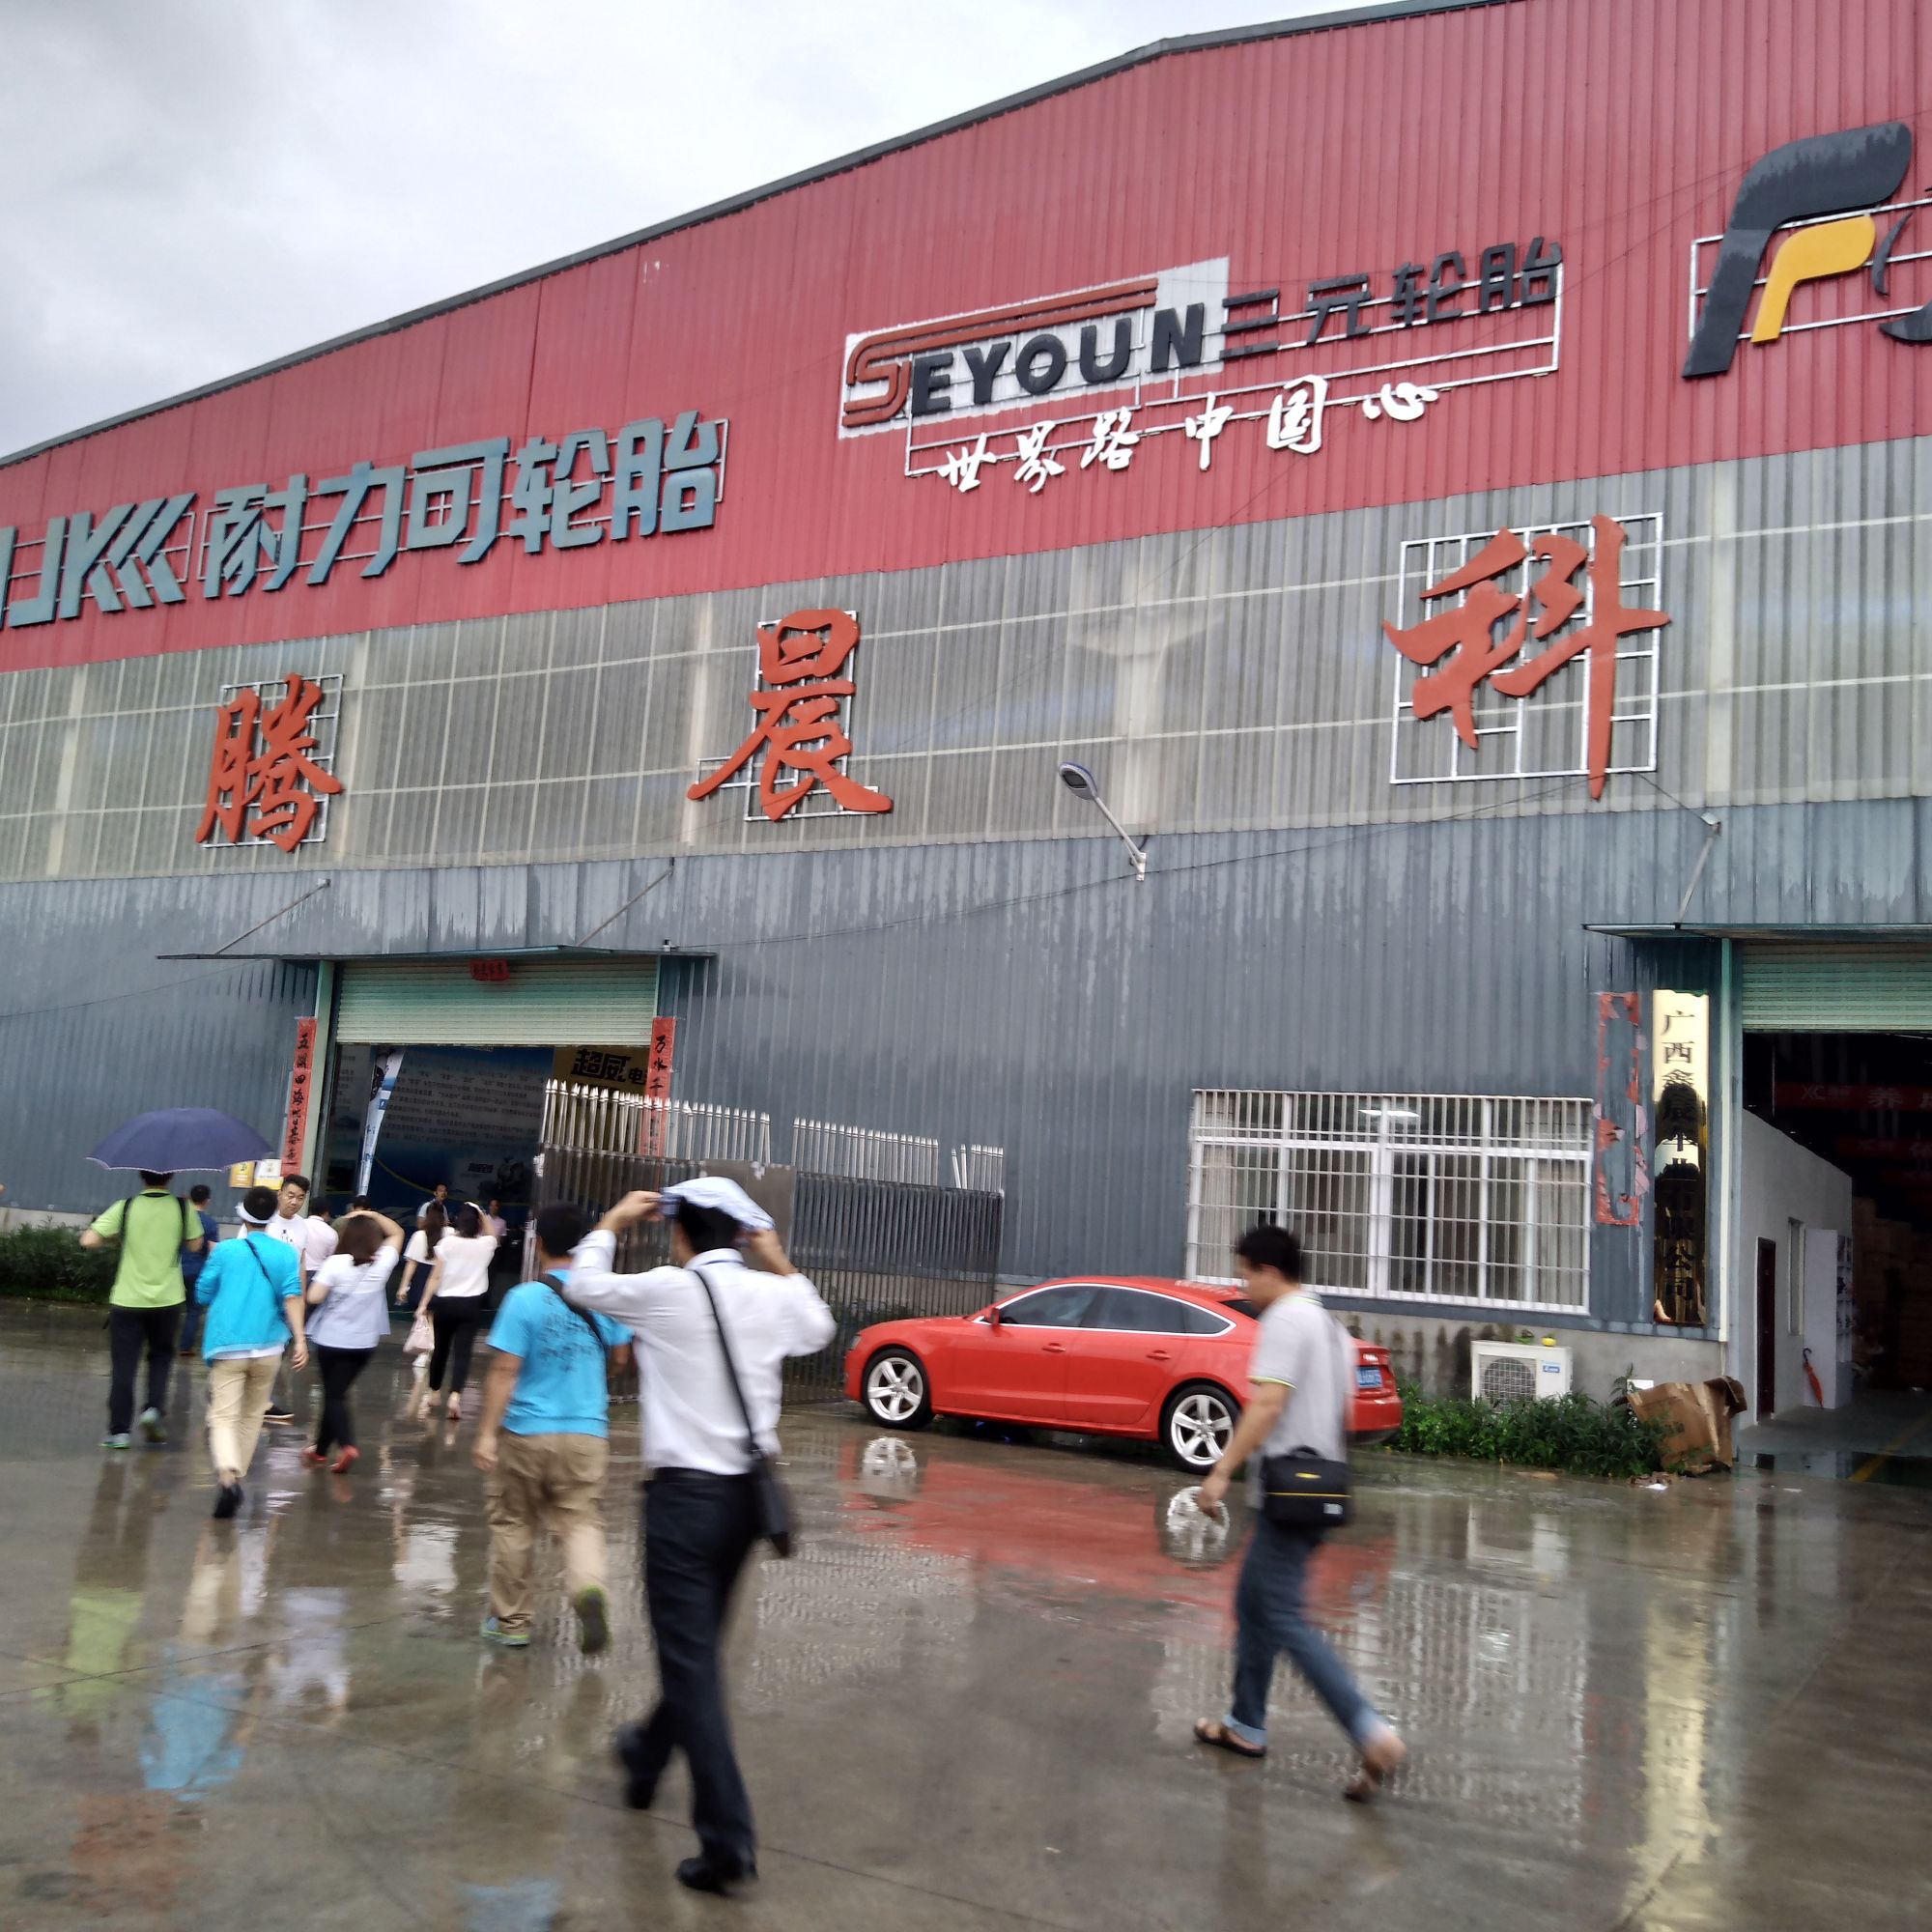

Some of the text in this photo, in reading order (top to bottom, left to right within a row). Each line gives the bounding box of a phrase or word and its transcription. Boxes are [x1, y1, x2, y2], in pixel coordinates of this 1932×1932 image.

[1221, 237, 1563, 360] 三元轮胎
[202, 410, 720, 598] 耐力可轮胎
